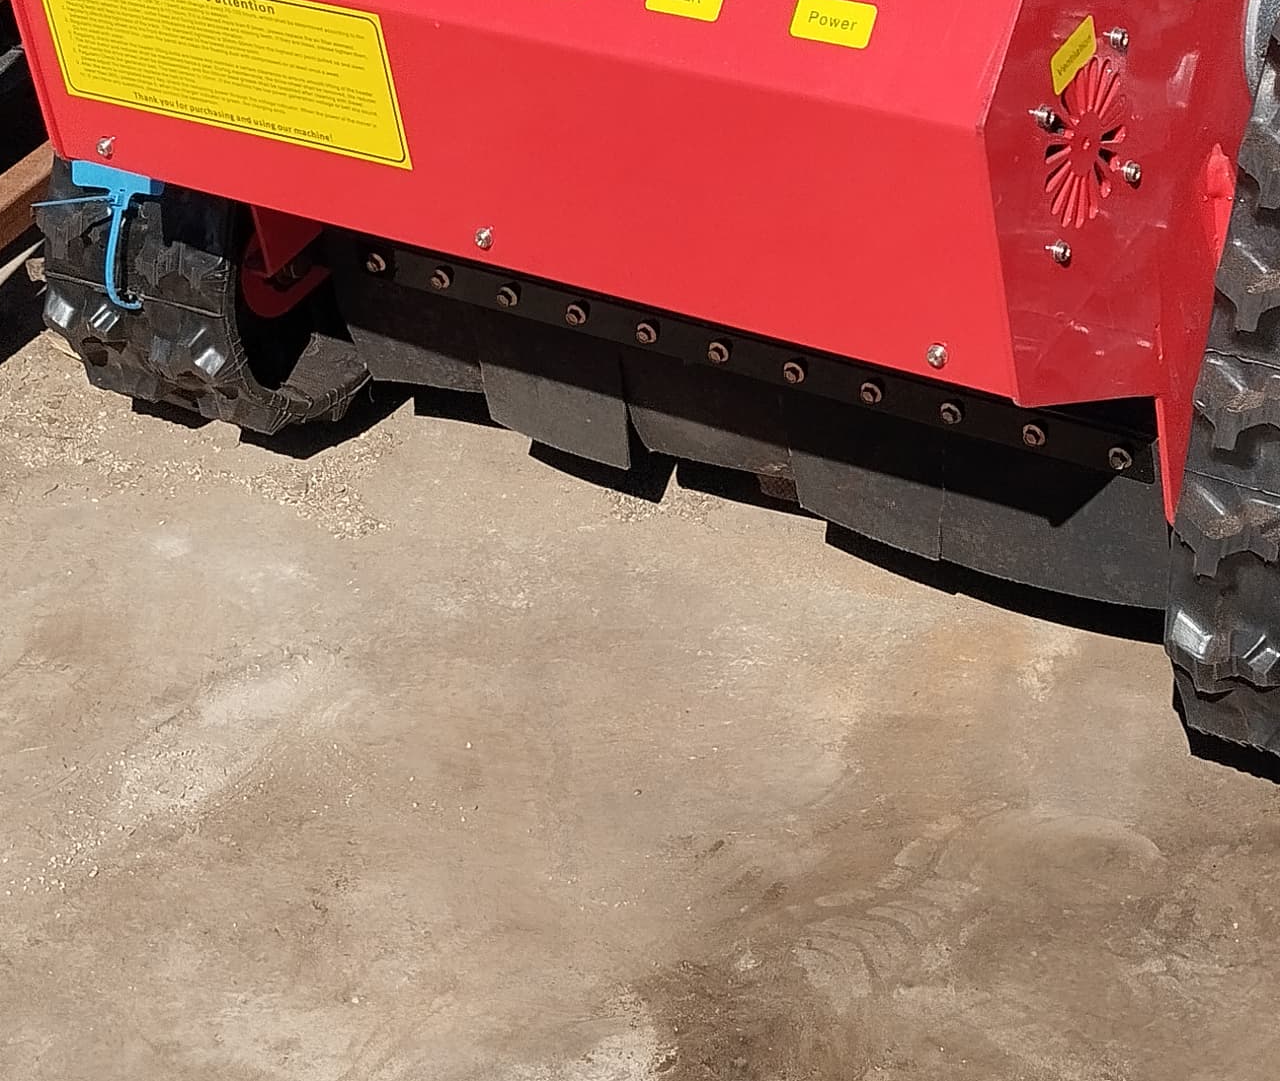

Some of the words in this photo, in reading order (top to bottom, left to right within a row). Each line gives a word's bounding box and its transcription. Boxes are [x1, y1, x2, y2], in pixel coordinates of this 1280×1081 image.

[808, 11, 858, 31] Power
[133, 91, 157, 103] Thank
[160, 98, 174, 107] you
[176, 101, 187, 110] for
[190, 105, 235, 122] purchasing
[236, 114, 251, 124] and
[253, 119, 276, 130] using
[277, 124, 291, 132] our
[293, 128, 333, 142] machine!
